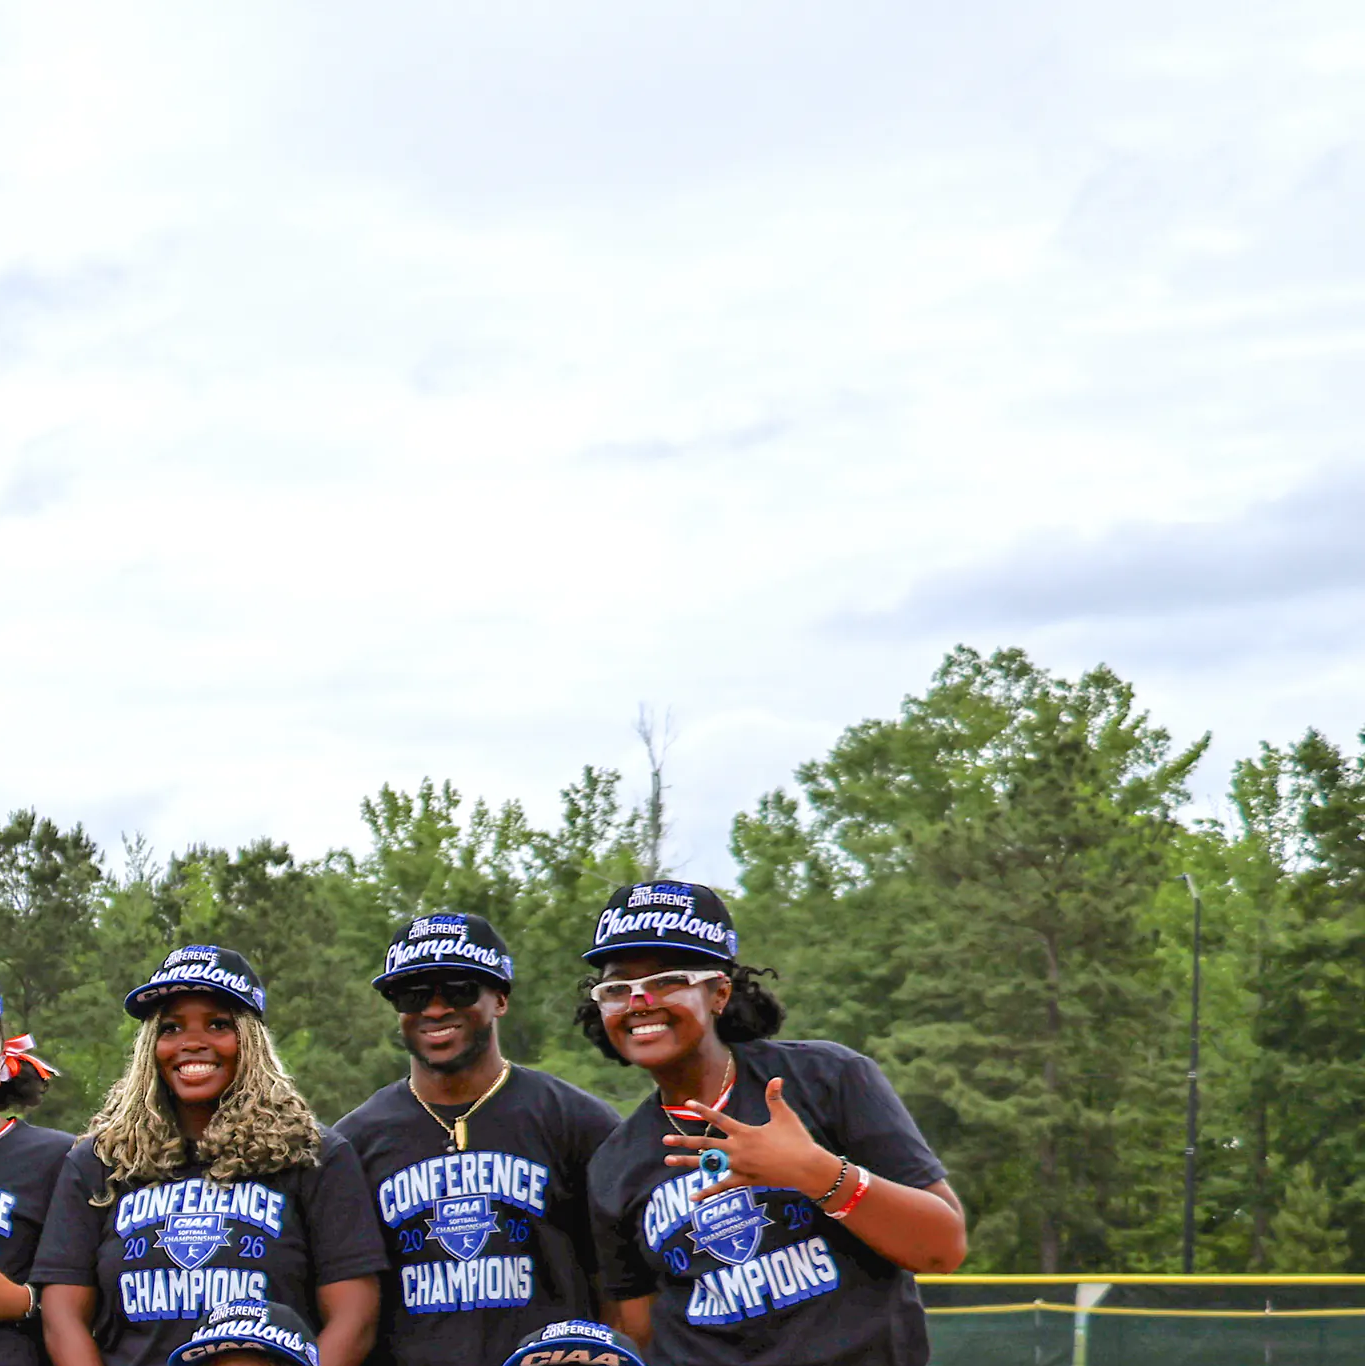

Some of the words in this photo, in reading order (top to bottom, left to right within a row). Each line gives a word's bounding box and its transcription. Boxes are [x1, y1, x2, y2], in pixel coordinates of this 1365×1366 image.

[628, 893, 695, 908] CONFERENCE
[408, 924, 468, 940] CONFERENCE
[595, 907, 727, 946] Champions
[164, 951, 218, 969] CONFERENCE
[386, 935, 501, 974] Champions
[379, 1152, 548, 1226] CONFERENCE
[116, 1179, 283, 1237] CONFERENCE
[442, 1200, 482, 1217] CIAA
[701, 1197, 743, 1223] CIAA
[174, 1217, 212, 1229] CIAA
[435, 1221, 491, 1235] CHAMPIONSHIP
[448, 1216, 478, 1226] SOFTBALL
[699, 1216, 760, 1246] CHAMPIONSHIP
[710, 1215, 742, 1231] SOFTBALL
[163, 1233, 221, 1243] CHAMPIONSHIP
[399, 1229, 424, 1254] 20
[506, 1219, 530, 1243] 26
[665, 1247, 690, 1276] 20
[784, 1204, 814, 1230] 26
[124, 1237, 147, 1260] 20
[239, 1235, 265, 1258] 26
[119, 1268, 266, 1322] CHAMPIONS
[401, 1256, 535, 1314] CHAMPIONS
[209, 1306, 268, 1324] CONFERENCE
[542, 1325, 614, 1344] CONFERENCE
[181, 1342, 266, 1362] CIAA
